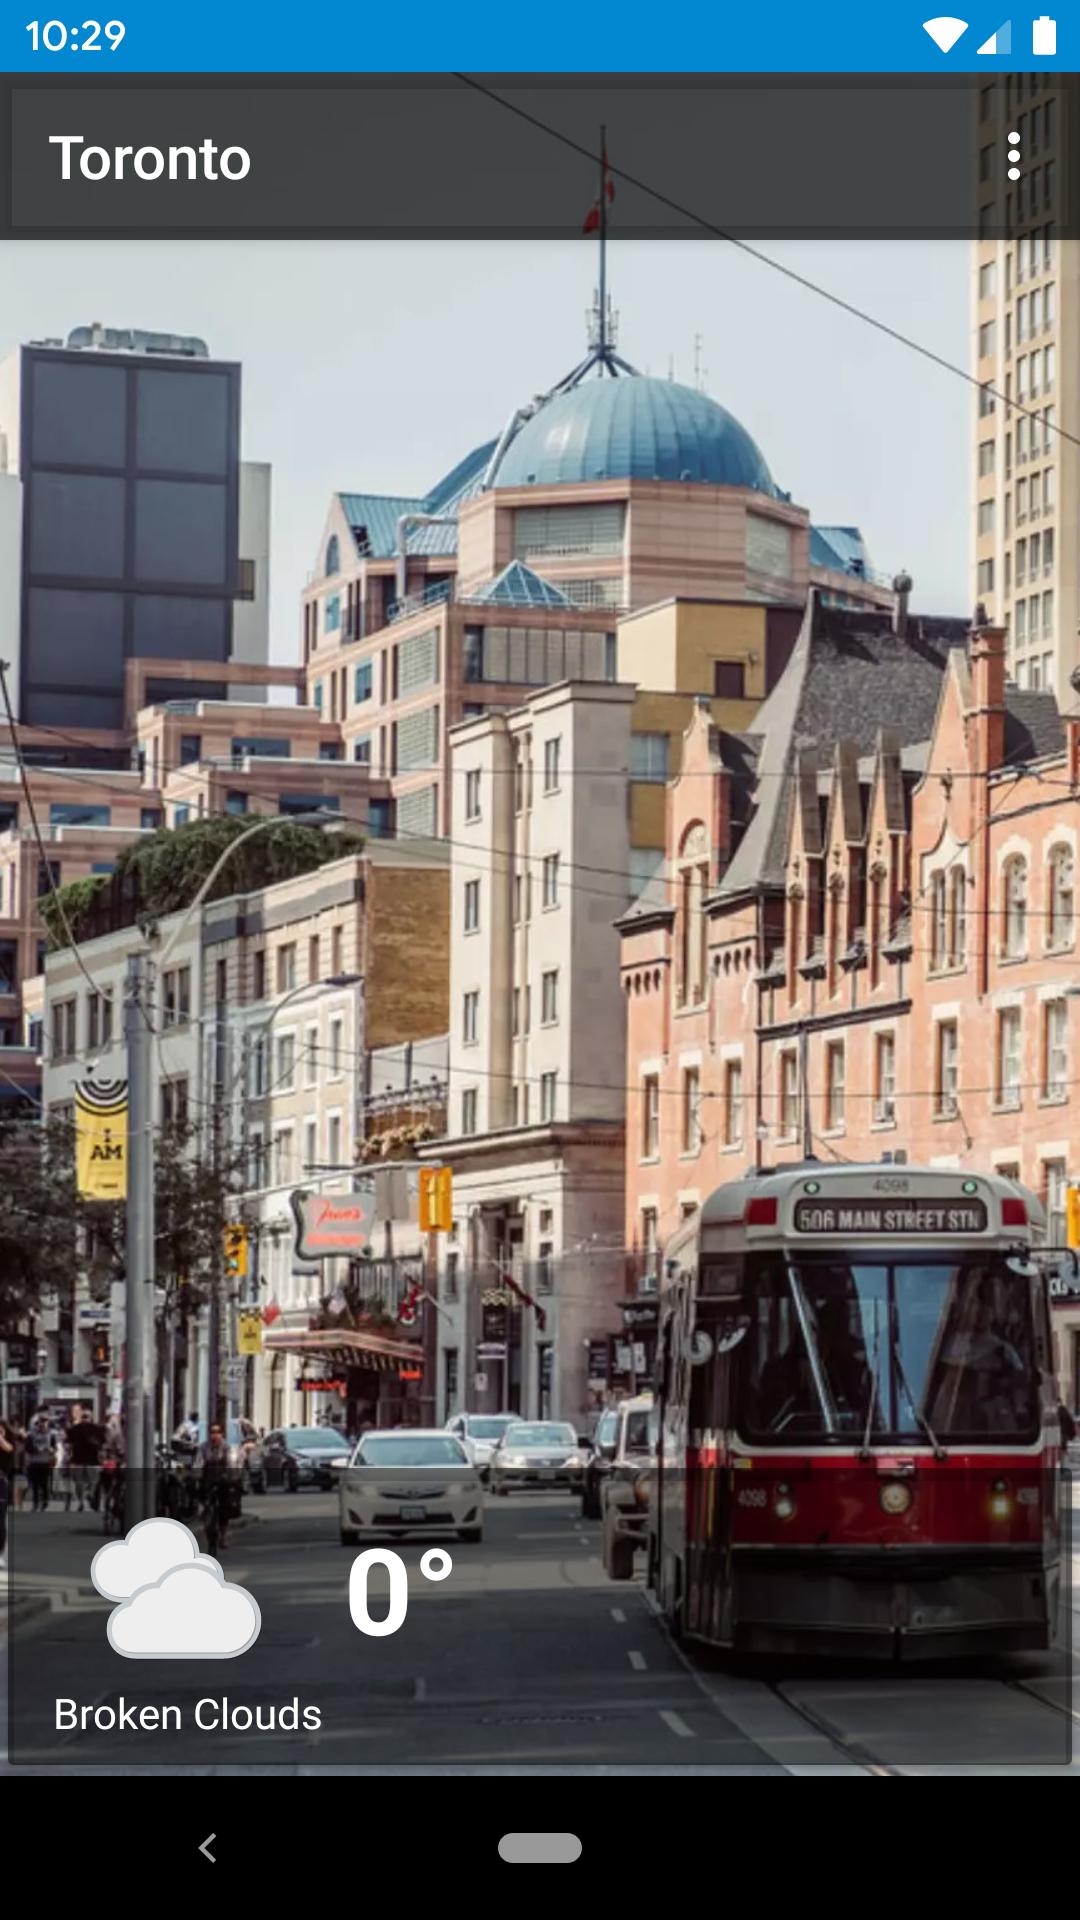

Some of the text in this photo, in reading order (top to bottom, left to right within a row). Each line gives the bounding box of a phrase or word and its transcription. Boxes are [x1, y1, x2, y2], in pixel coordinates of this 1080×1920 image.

[90, 1145, 123, 1160] AM
[872, 1178, 909, 1193] 4098
[800, 1209, 979, 1230] 506 MAIN STREET STN
